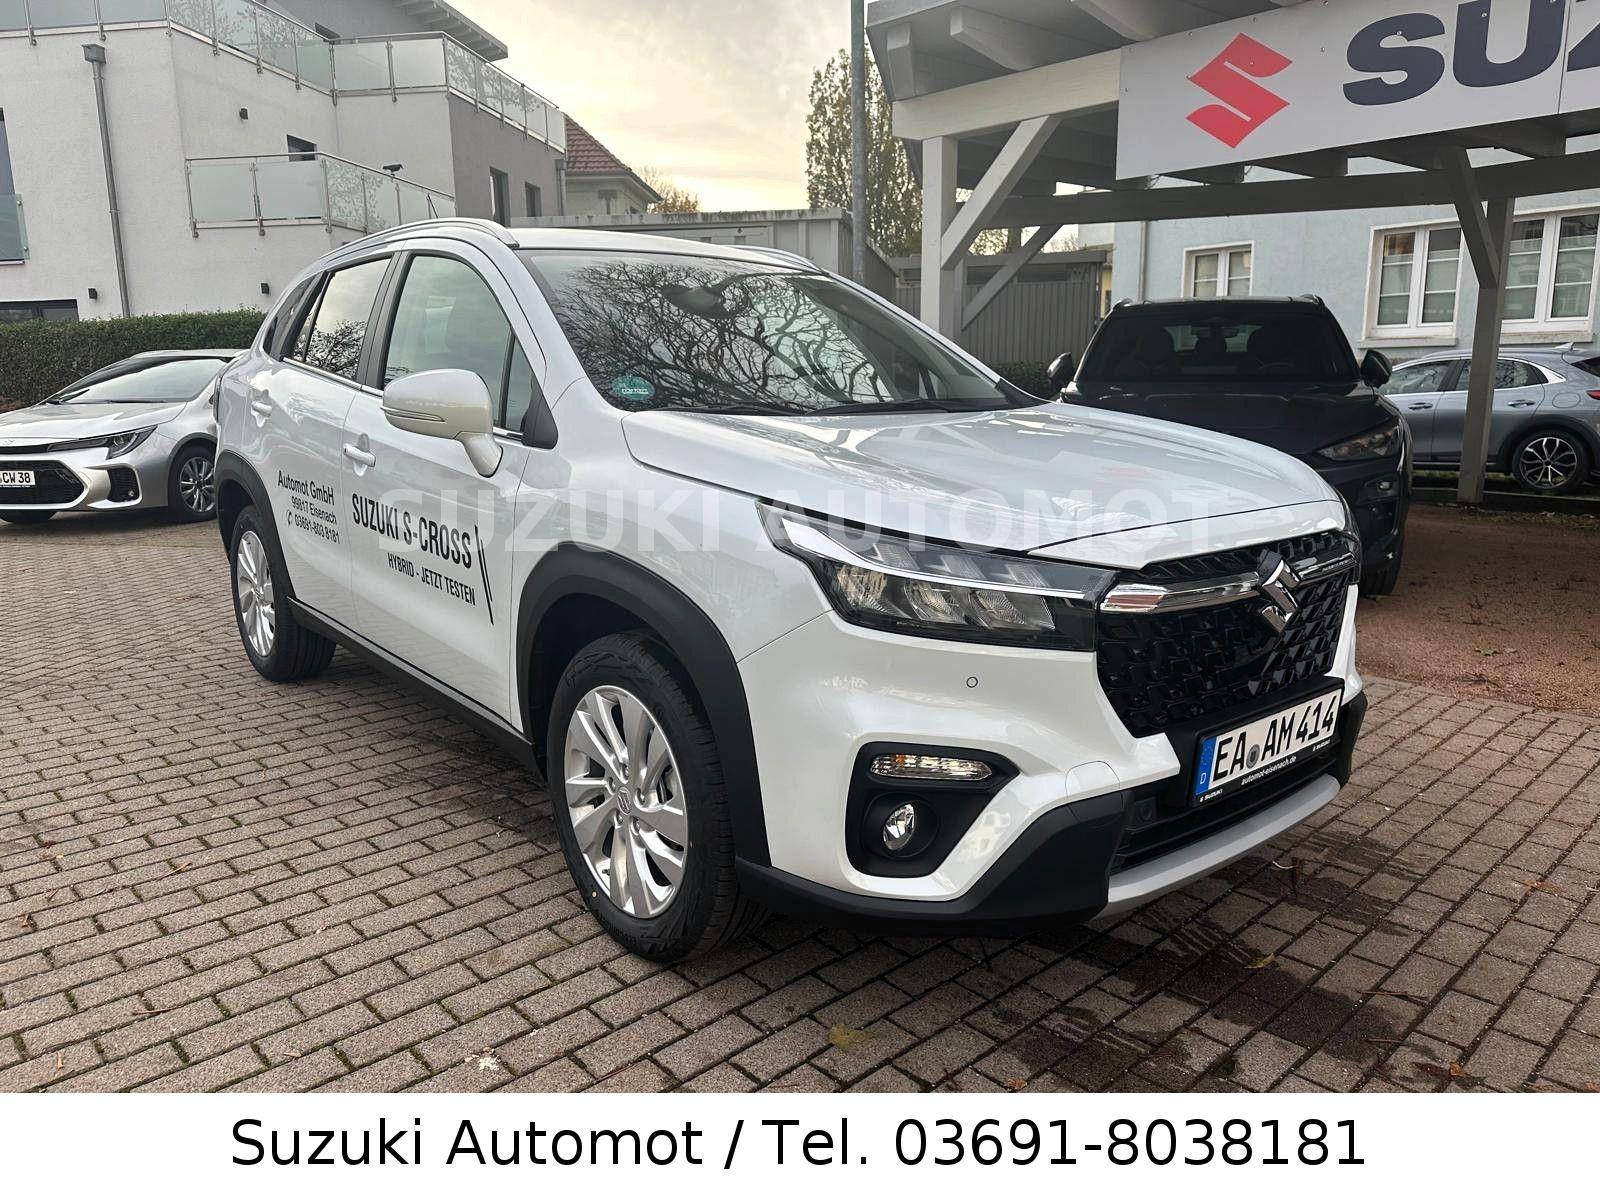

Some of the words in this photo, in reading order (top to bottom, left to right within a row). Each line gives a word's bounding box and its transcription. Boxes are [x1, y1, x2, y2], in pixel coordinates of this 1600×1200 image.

[2, 472, 16, 484] CW
[17, 472, 31, 484] 38
[278, 470, 310, 497] Automot
[310, 481, 335, 506] GmbH
[309, 502, 337, 525] Eisenach
[352, 493, 399, 540] SUZUKI
[403, 511, 472, 569] S-CROSS
[387, 552, 415, 578] HYBRID
[421, 566, 443, 590] JETZT
[444, 576, 476, 606] TESTEN
[1213, 731, 1247, 782] EA
[1261, 711, 1295, 762] AM
[1296, 695, 1337, 743] 414
[1240, 755, 1297, 786] automot-eisenach.de
